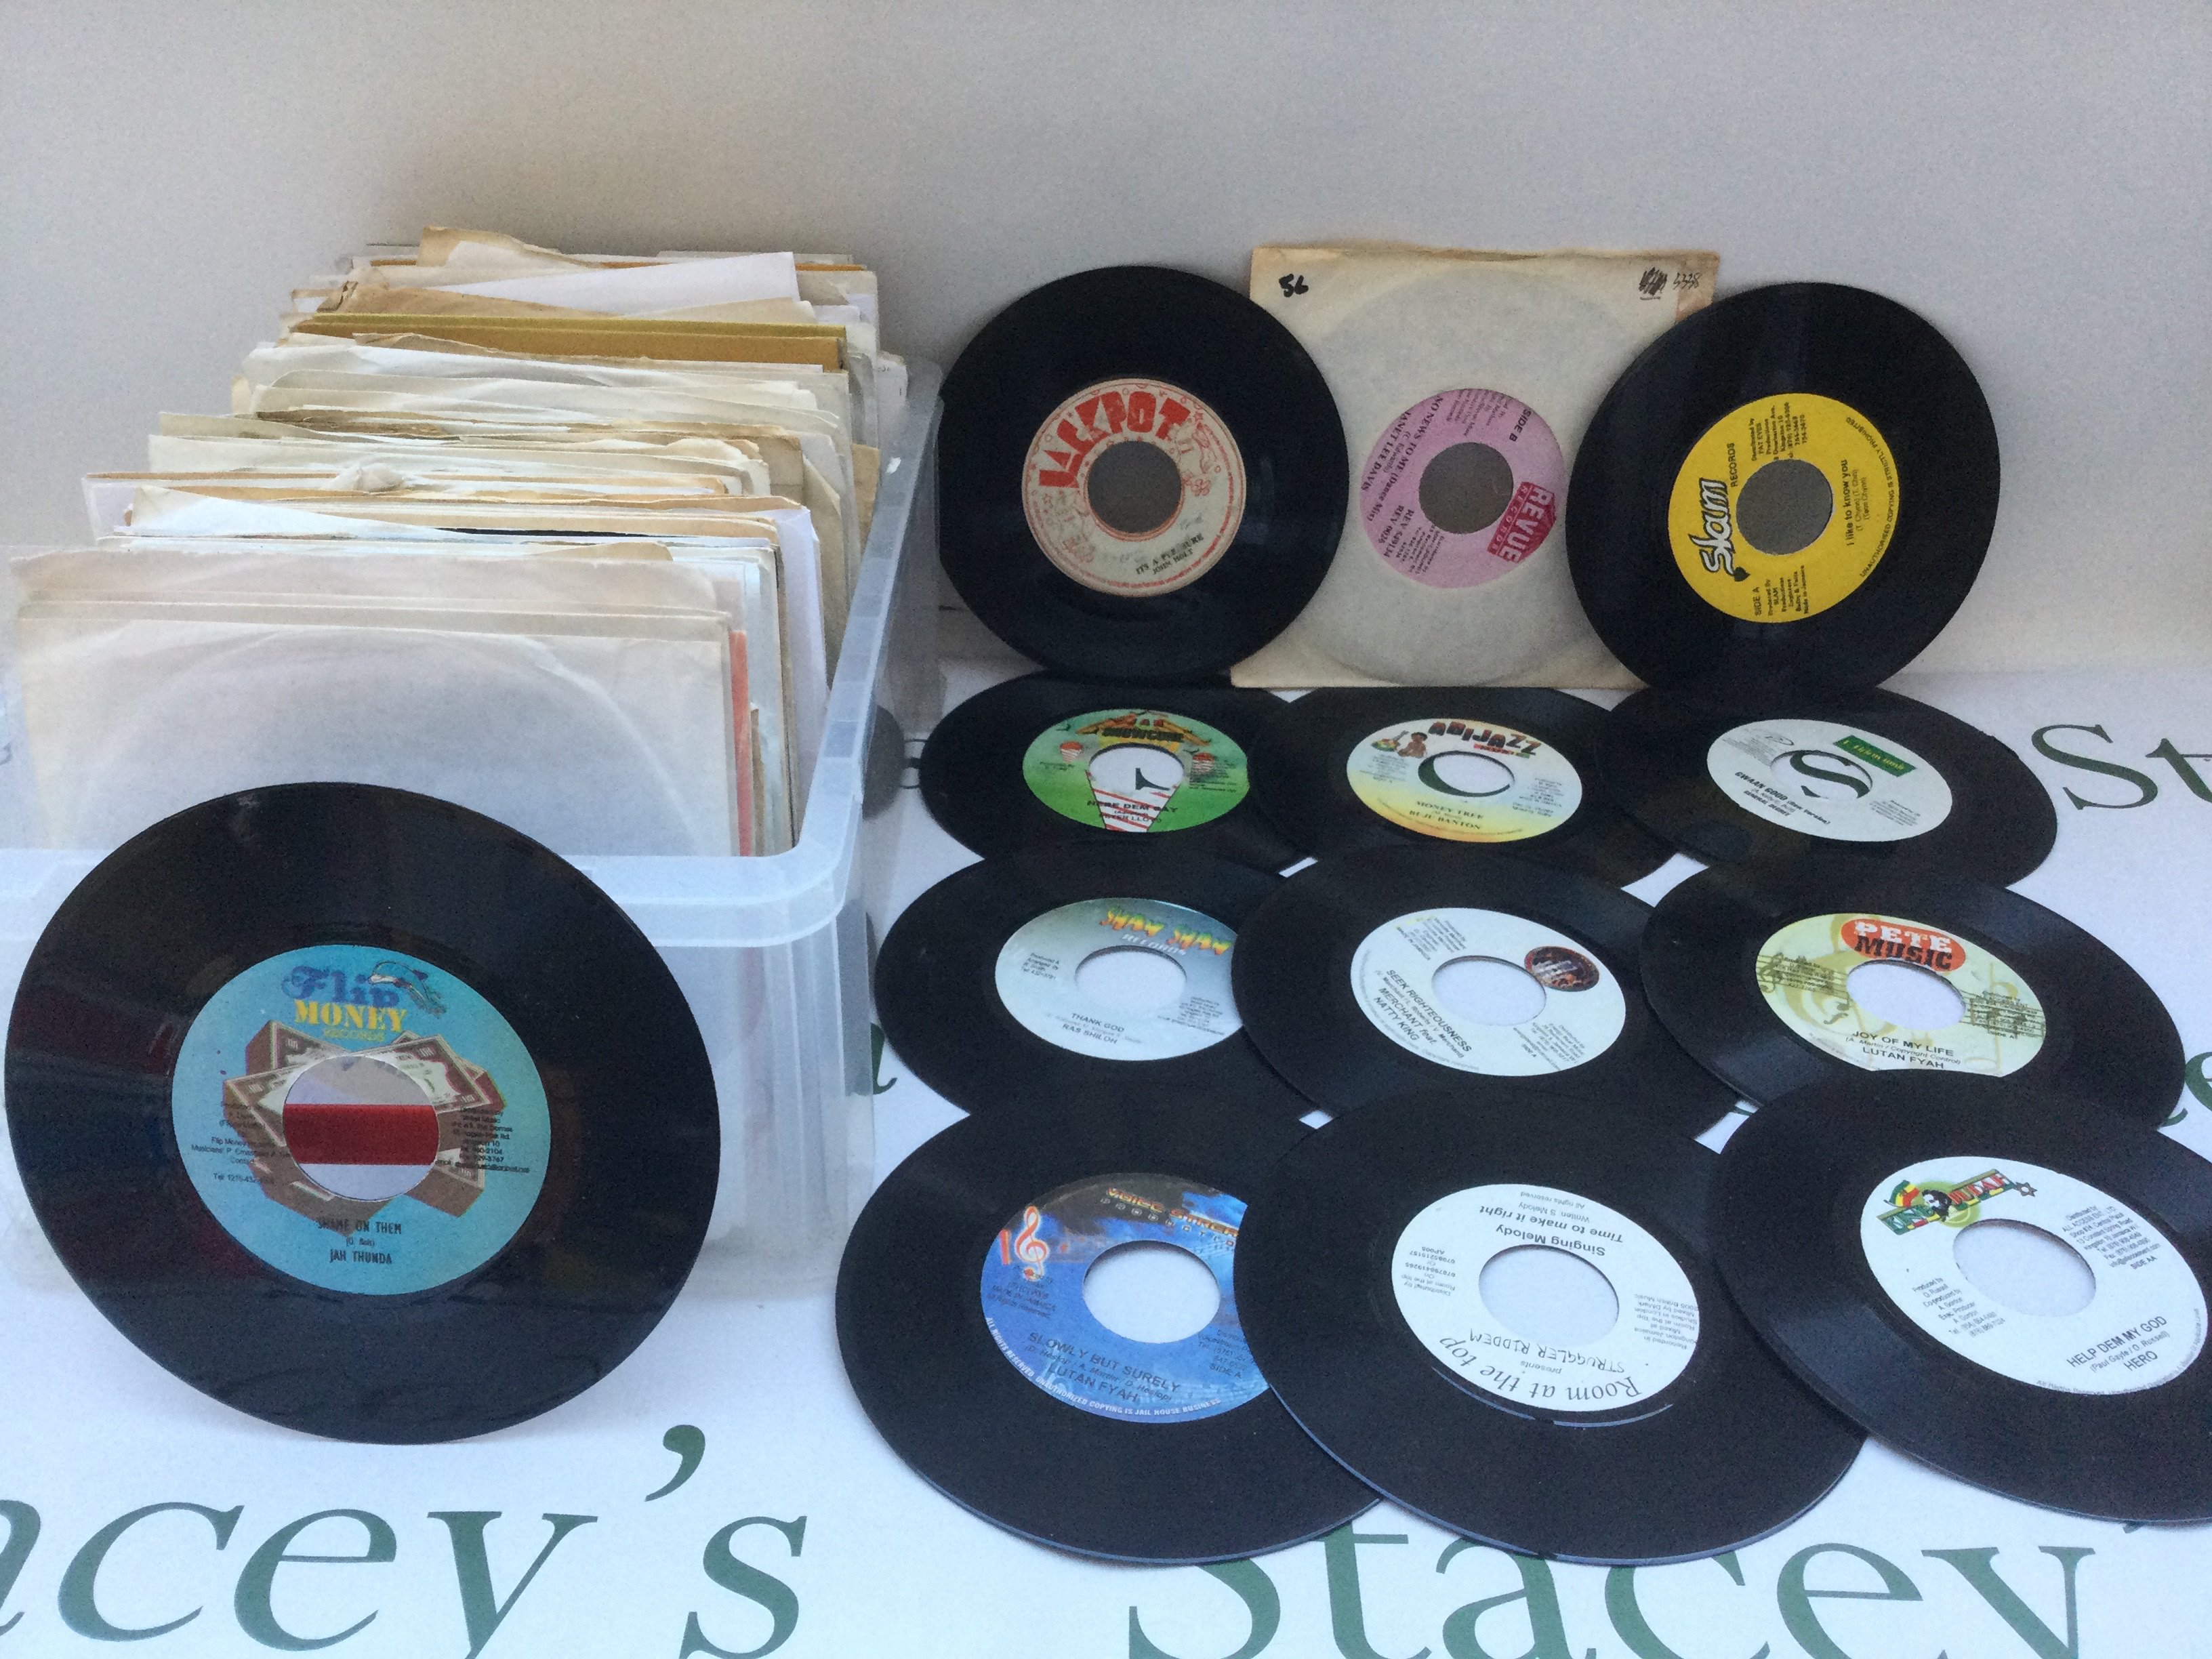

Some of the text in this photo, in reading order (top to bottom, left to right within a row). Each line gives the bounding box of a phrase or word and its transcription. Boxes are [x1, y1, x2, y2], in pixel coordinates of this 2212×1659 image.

[1431, 395, 1443, 411] NO
[1414, 411, 1435, 441] NEWS
[1509, 408, 1532, 442] SIDE B
[1038, 391, 1192, 489] JACKPOT
[1361, 411, 1411, 491] JANET LEE DAVIS
[1406, 441, 1417, 457] TO
[1726, 442, 1738, 488] RECORDS
[1841, 458, 1851, 478] you
[1842, 480, 1851, 508] know
[1390, 504, 1404, 525] REV
[1400, 509, 1414, 529] REV
[1490, 485, 1529, 551] RECORDS
[1498, 486, 1553, 563] REVUE
[1844, 509, 1853, 523] to
[1845, 522, 1855, 542] like
[1734, 771, 1766, 789] GWAAN
[1853, 920, 1952, 954] PETE
[1853, 935, 1953, 971] MUSIC
[281, 965, 400, 1010] Flip
[294, 998, 407, 1033] MONEY
[1374, 996, 1420, 1042] NATTY KING
[1378, 987, 1424, 1028] MERCHANT
[1386, 969, 1411, 990] SEEK
[1406, 989, 1473, 1052] RIGHTEOUSNESS
[1062, 1023, 1082, 1034] RAS
[1082, 1029, 1119, 1045] SHILOH
[1071, 1012, 1126, 1033] THANK GOD
[1851, 1031, 1954, 1057] JOY OF MY LIFE
[1862, 1046, 1945, 1069] LUTAN FYAH
[1890, 1046, 1929, 1059] Copyright
[1518, 1201, 1547, 1215] Melody
[1520, 1191, 1553, 1202] reserved
[1554, 1197, 1574, 1207] rights
[375, 1221, 402, 1235] THEM
[1479, 1206, 1623, 1243] Time to make it right
[1495, 1224, 1605, 1256] Singing Melody
[329, 1248, 392, 1265] JAH THUNDA
[1414, 1284, 1451, 1296] Distributed
[1633, 1294, 1655, 1303] Music
[1469, 1328, 1625, 1374] STRUGGLER RIDDEM
[1652, 1338, 1687, 1350] Recorded
[2066, 1315, 2168, 1368] HELP DEM MY GOD
[2089, 1361, 2110, 1373] (Paul
[2141, 1330, 2171, 1347] Russell)
[985, 1316, 996, 1329] ALL
[991, 1328, 1010, 1352] RIGHTS
[1004, 1349, 1036, 1378] RESERVED
[1035, 1376, 1088, 1406] UNAUTHORIZED
[1089, 1400, 1123, 1414] COPYING
[1134, 1408, 1152, 1416] JAIL
[1153, 1408, 1181, 1416] HOUSE
[1183, 1397, 1221, 1414] BUSINESS
[1029, 1332, 1181, 1393] SLOWLY BUT SURELY
[1208, 1362, 1242, 1379] SIDE A
[1439, 1336, 1643, 1401] Room at the top
[1519, 1359, 1562, 1375] presents
[2123, 1350, 2158, 1372] HERO
[1047, 1365, 1141, 1403] LUTAN FYAH
